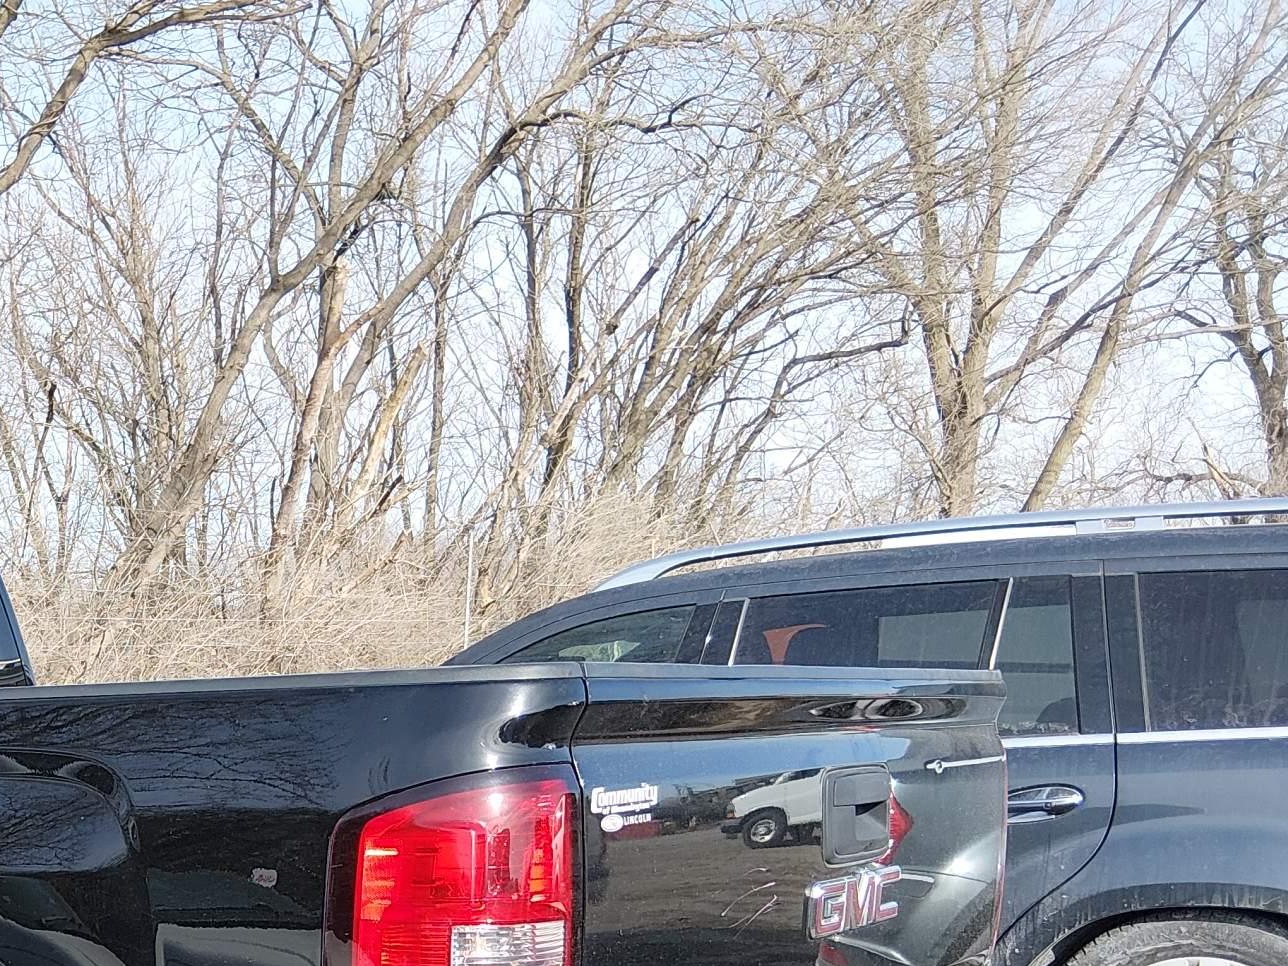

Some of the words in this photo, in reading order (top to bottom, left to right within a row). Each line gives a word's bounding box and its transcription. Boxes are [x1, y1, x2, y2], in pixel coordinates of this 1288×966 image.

[590, 782, 659, 814] Community
[623, 813, 652, 826] LINCOLN
[806, 863, 902, 939] GMC
